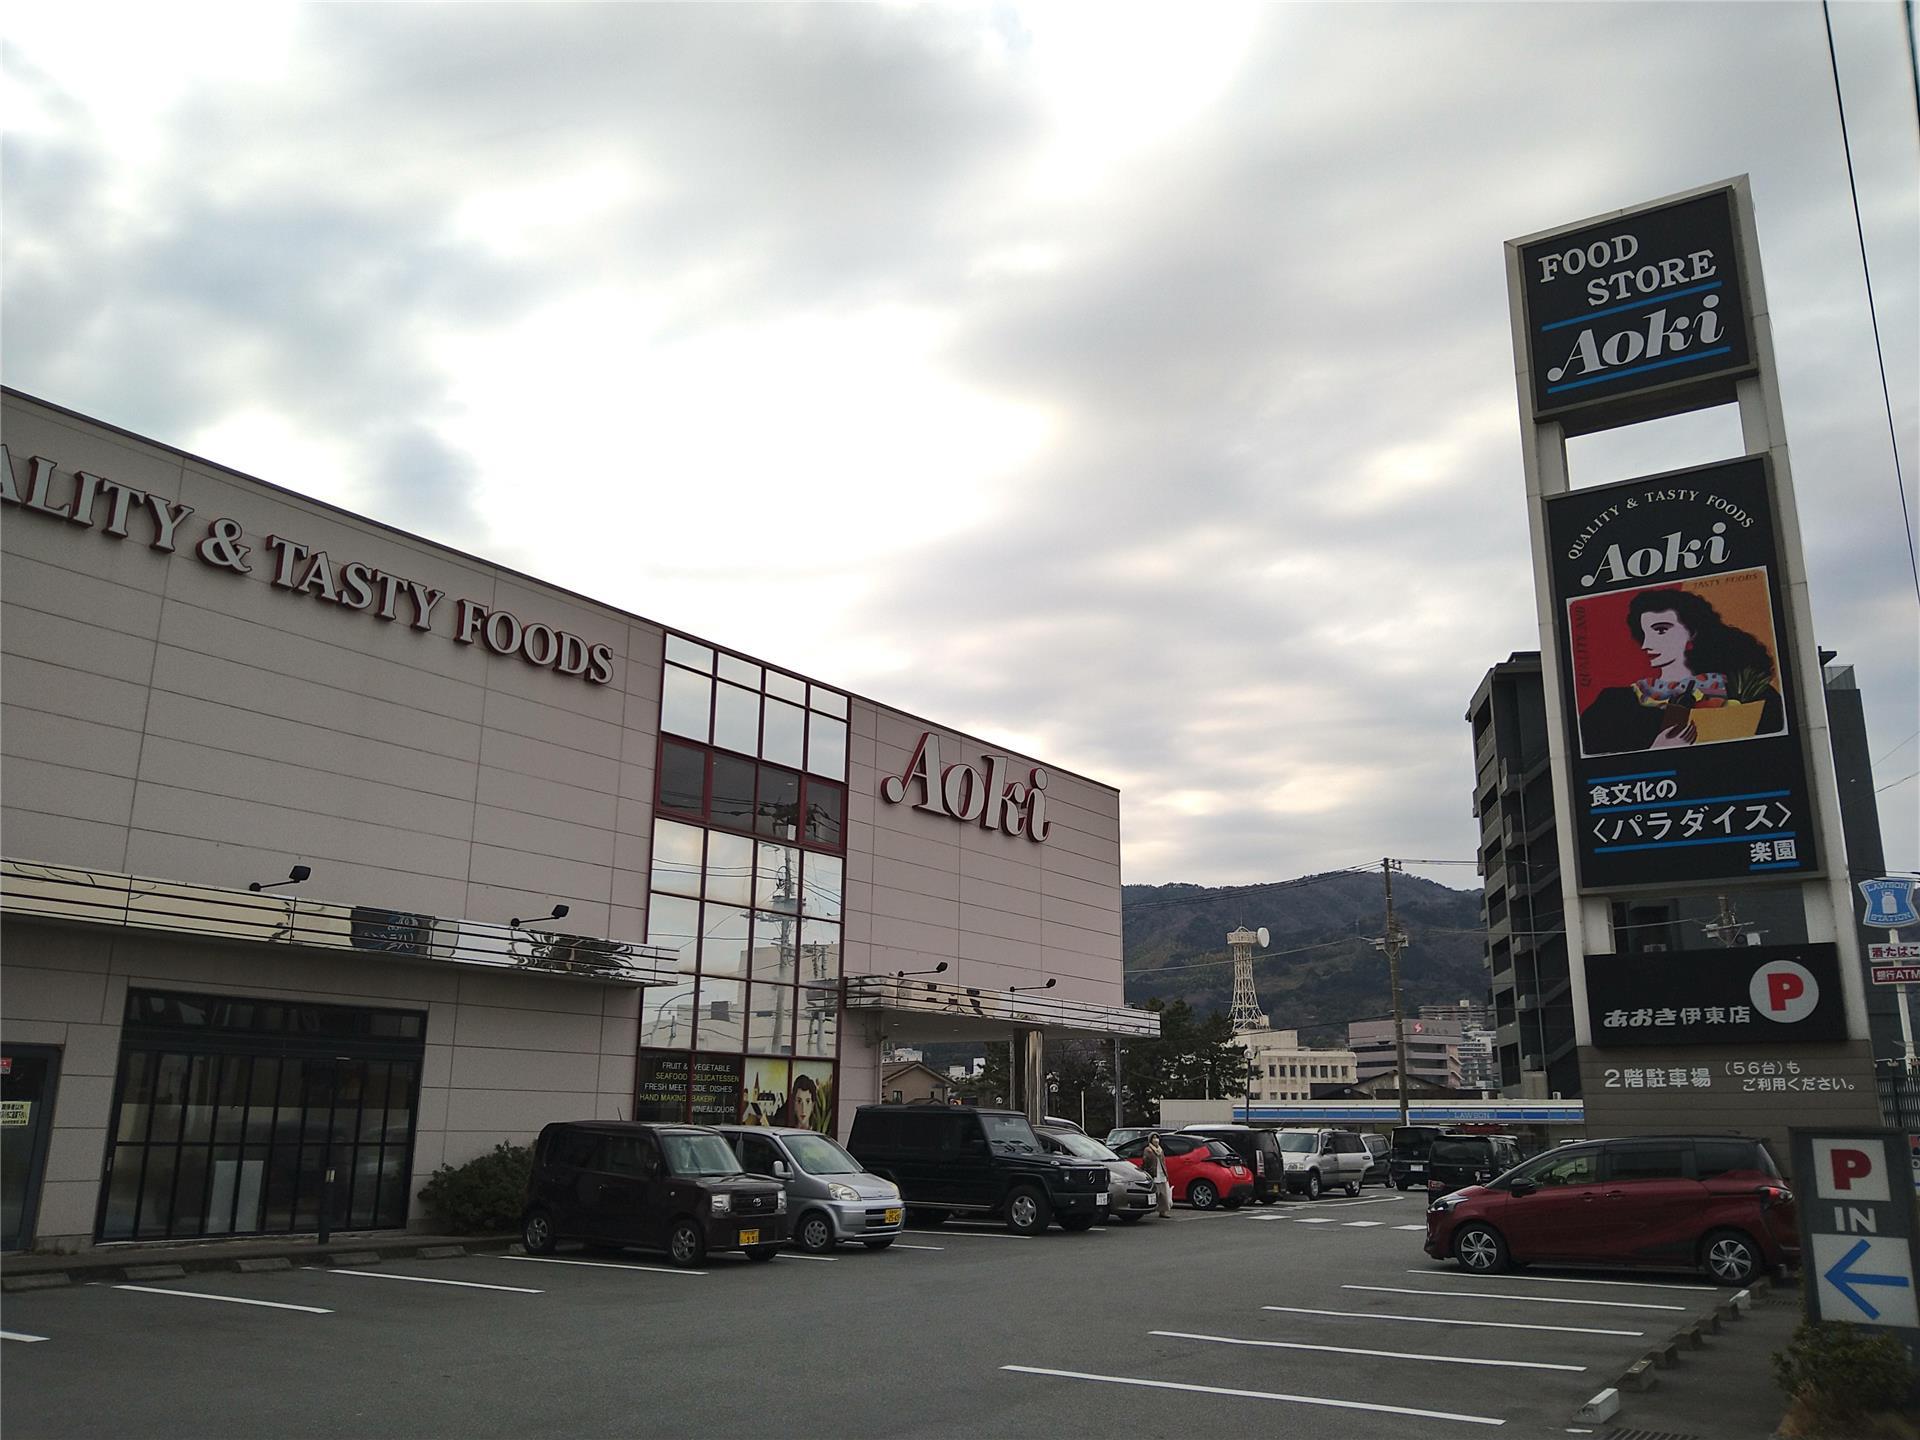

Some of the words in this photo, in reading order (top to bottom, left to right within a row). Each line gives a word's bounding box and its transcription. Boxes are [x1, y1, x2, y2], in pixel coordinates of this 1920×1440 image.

[1538, 234, 1638, 283] FOOD
[1587, 249, 1717, 306] STORE
[1547, 294, 1725, 382] Aoki
[1568, 505, 1620, 560] QUALITY
[1626, 497, 1639, 510] &
[1644, 489, 1699, 503] TASTY
[1706, 495, 1755, 528] FOODS
[1581, 522, 1731, 587] Aoki
[198, 518, 251, 573] &
[266, 534, 445, 632] TASTY
[453, 598, 614, 685] FOODS
[881, 731, 1051, 843] Aoki
[1589, 779, 1677, 807] 食文化の
[1750, 839, 1797, 862] 楽園
[1767, 972, 1804, 1011] P
[1603, 1006, 1751, 1028] あおき伊東店
[656, 1072, 687, 1080] SEAFOOD
[693, 1063, 730, 1072] VEGETABLE
[1603, 1067, 1711, 1089] 2階駐車場
[660, 1094, 686, 1102] MAKING
[692, 1084, 706, 1092] SIDE
[709, 1085, 733, 1093] DISHES
[1743, 1077, 1855, 1091] ご利用ください。
[1830, 1149, 1872, 1190] P
[1834, 1206, 1877, 1233] IN
